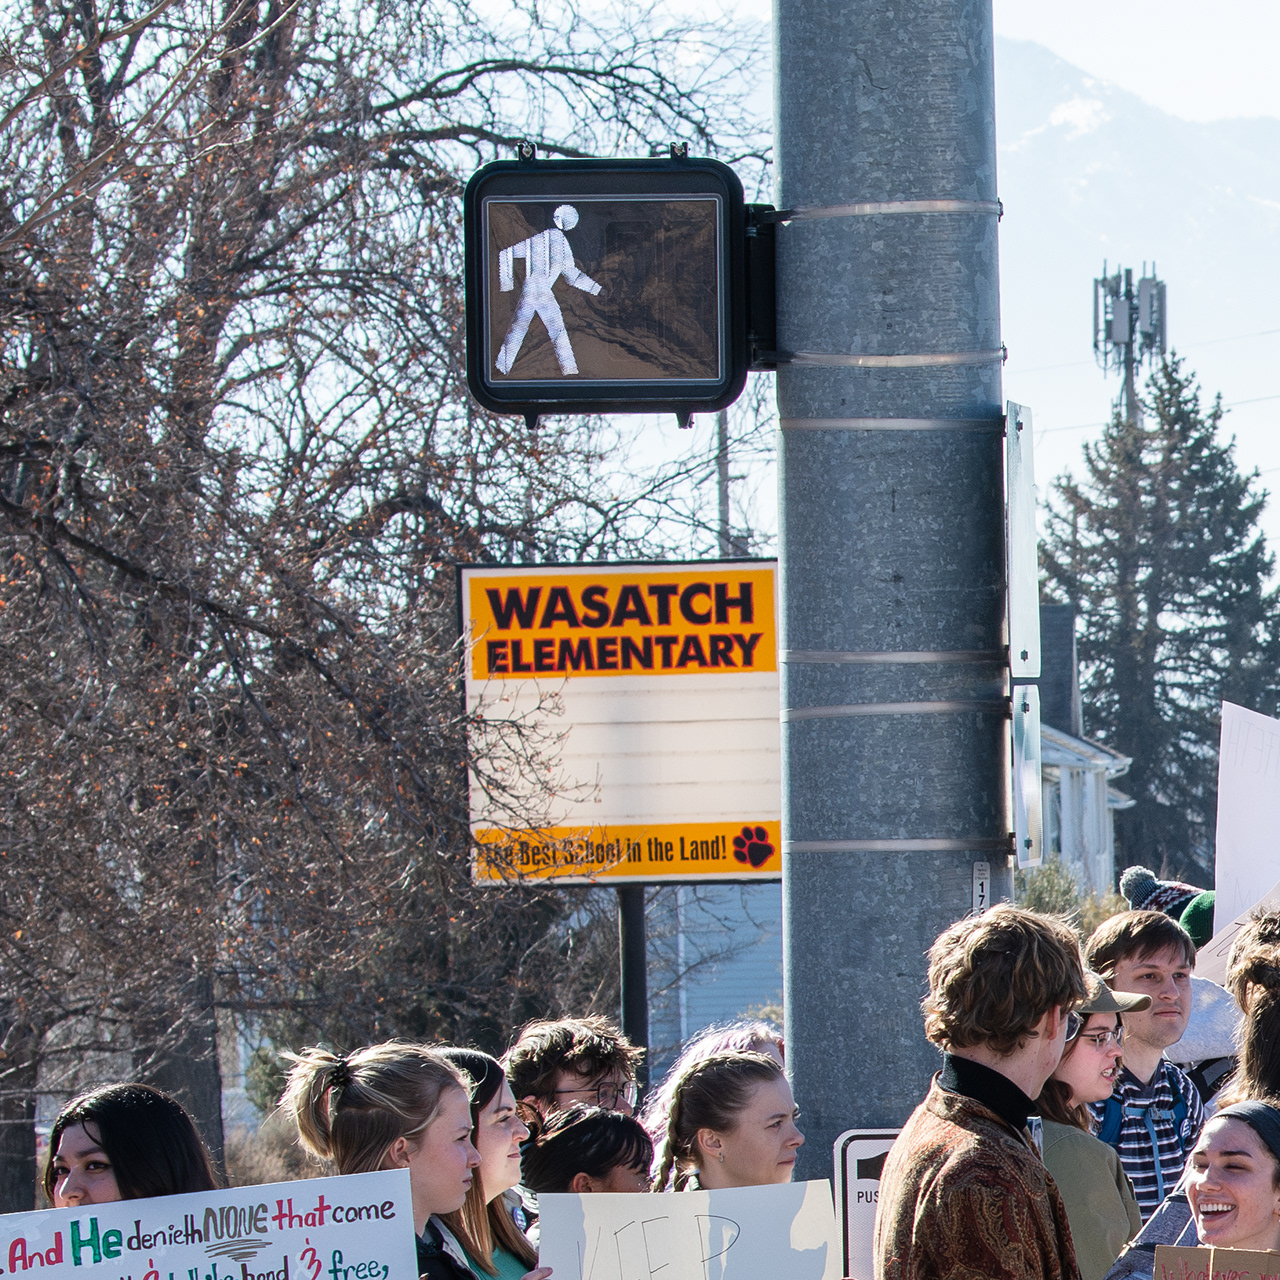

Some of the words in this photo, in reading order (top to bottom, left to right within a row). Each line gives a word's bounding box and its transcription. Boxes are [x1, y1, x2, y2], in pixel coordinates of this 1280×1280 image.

[485, 581, 754, 630] WASATCH
[486, 632, 764, 674] ELEMENTARY
[564, 838, 620, 864] School
[627, 838, 641, 864] in
[648, 838, 674, 862] the
[680, 835, 726, 862] Land!
[857, 1190, 880, 1203] PUS
[71, 1217, 123, 1267] He
[127, 1214, 203, 1252] denieth
[203, 1204, 269, 1244] NONE
[272, 1195, 331, 1232] that
[331, 1199, 396, 1224] come
